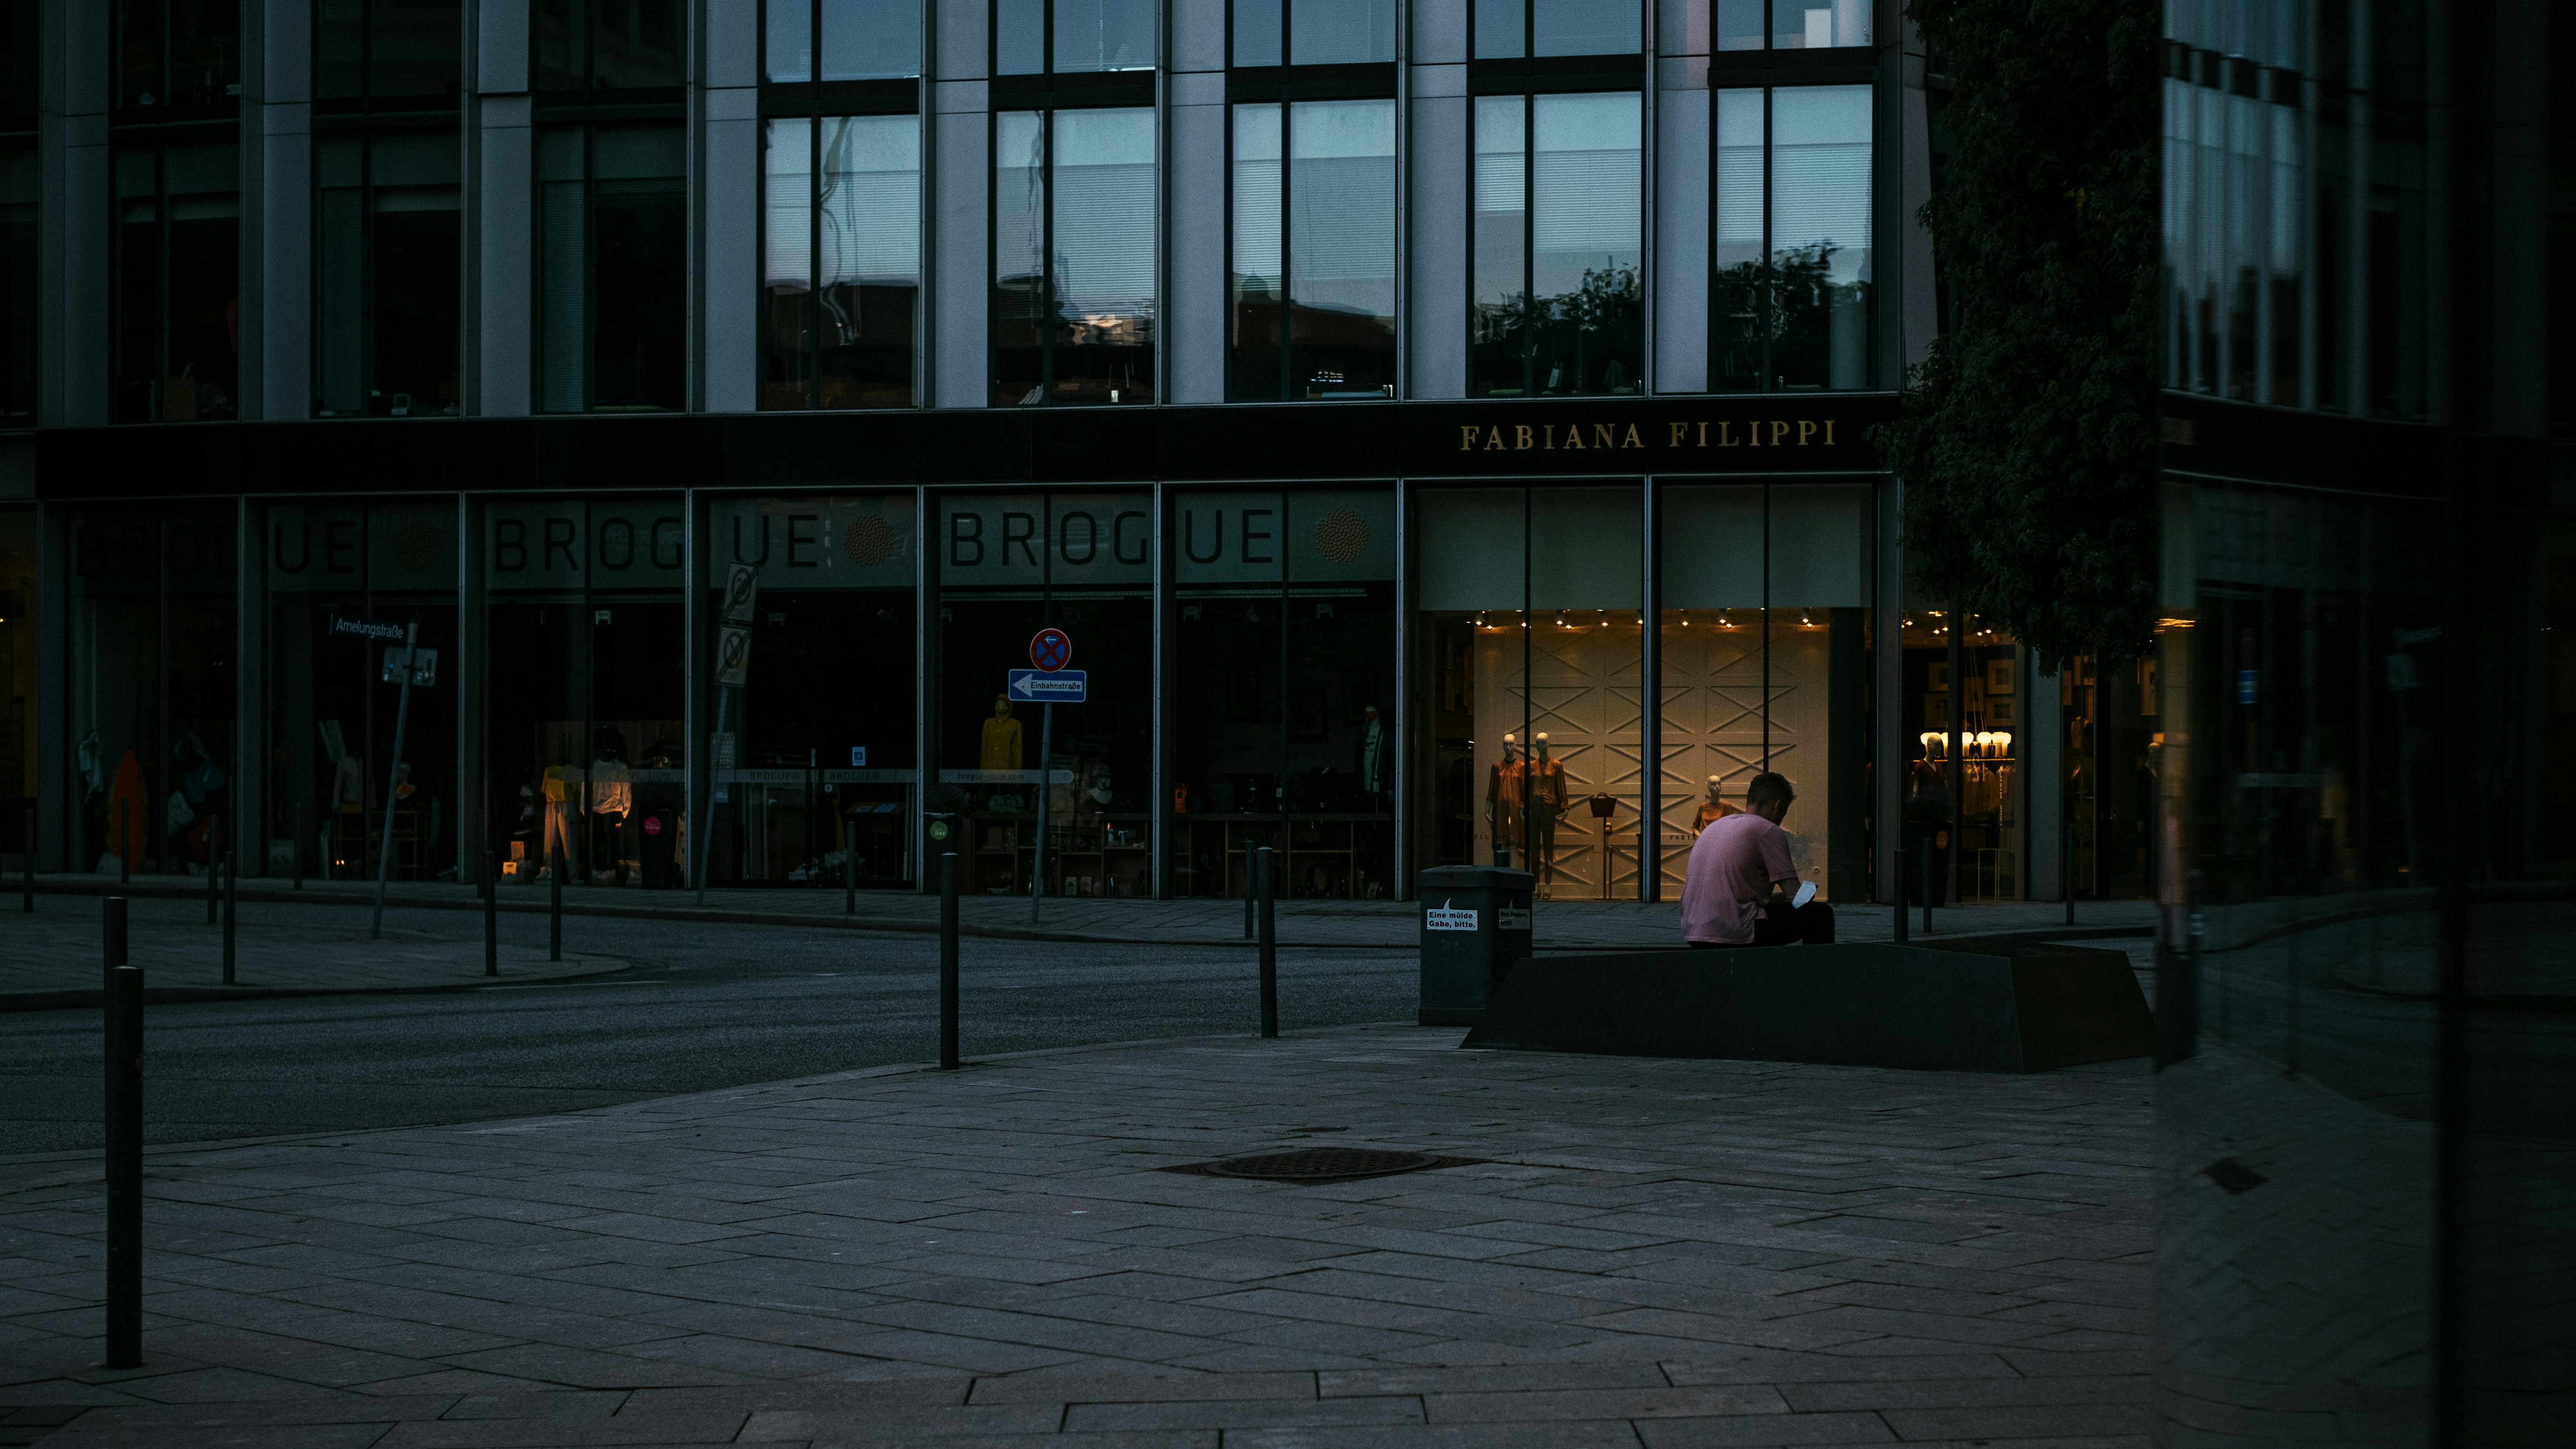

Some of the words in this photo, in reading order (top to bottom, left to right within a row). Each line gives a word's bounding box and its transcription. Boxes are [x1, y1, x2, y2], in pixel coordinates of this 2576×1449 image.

[1461, 423, 1645, 451] FABIANA
[1669, 419, 1836, 448] FILIPPI
[495, 514, 817, 572] BROGUE
[950, 509, 1272, 566] BROGUE
[336, 617, 404, 638] Amelungstraße
[1031, 682, 1081, 690] Einbahnstraße
[750, 772, 791, 781] BROGUE
[830, 772, 870, 781] BROGUE
[958, 772, 1024, 781] brogue-store.com
